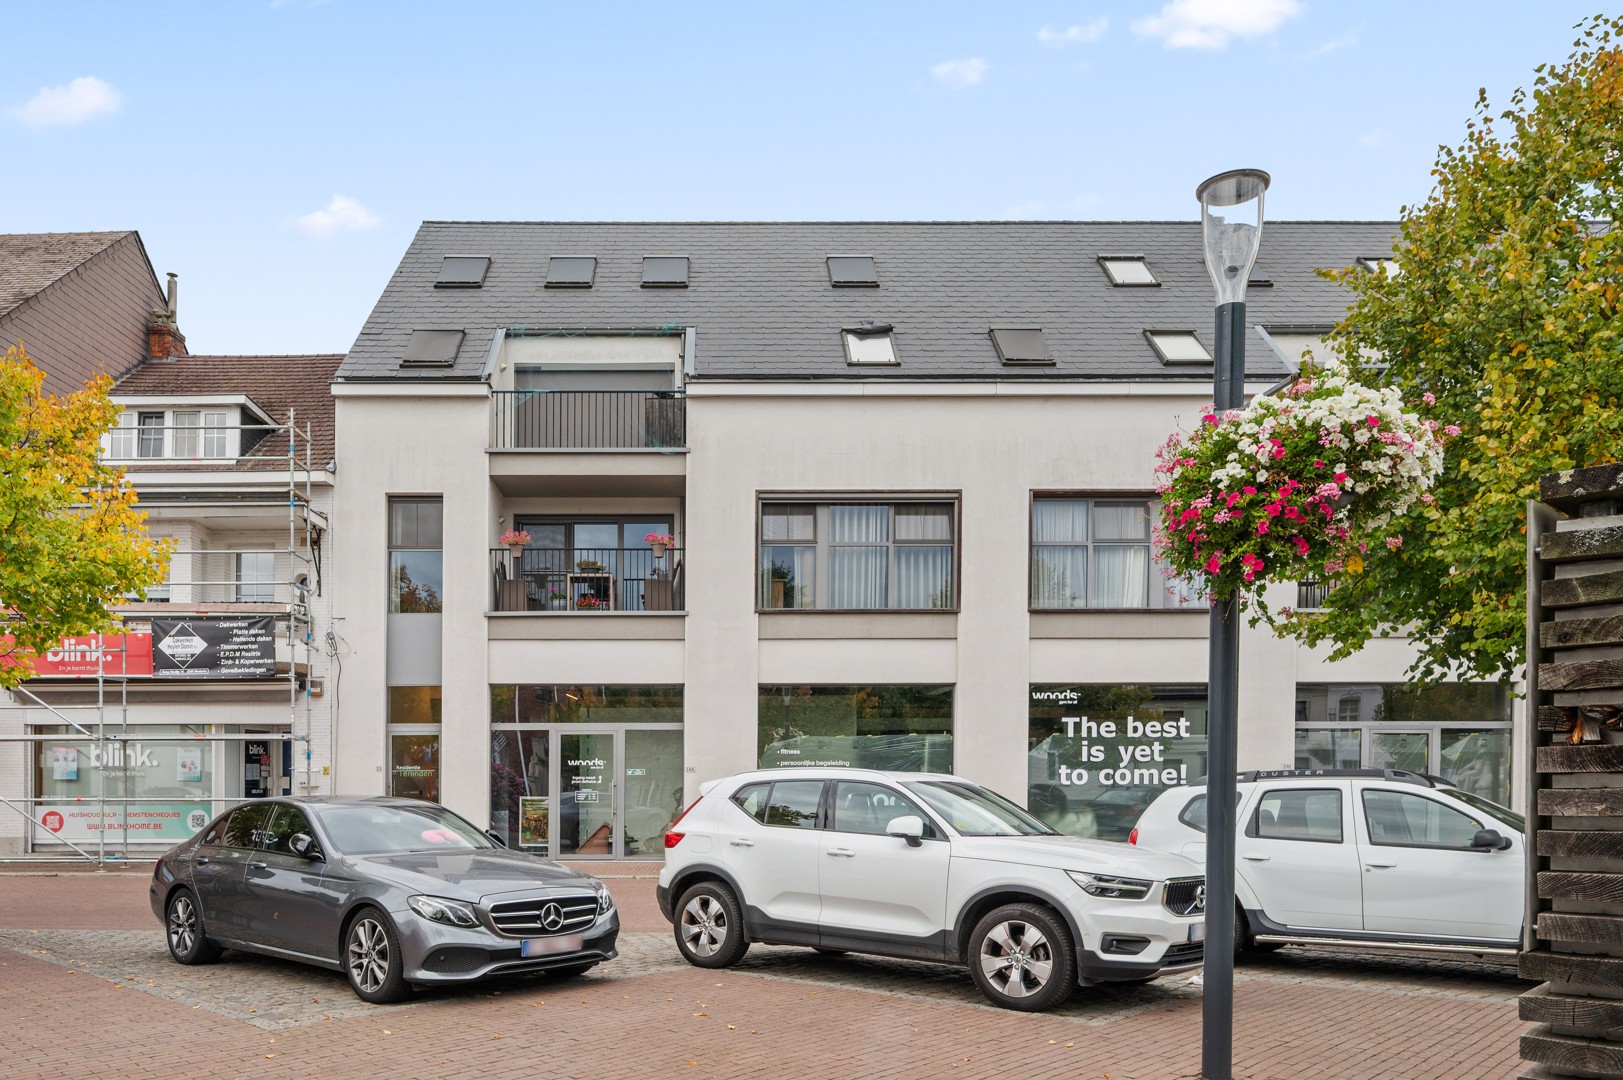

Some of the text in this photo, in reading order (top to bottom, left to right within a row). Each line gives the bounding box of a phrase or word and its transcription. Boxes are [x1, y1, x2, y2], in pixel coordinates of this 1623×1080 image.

[47, 638, 113, 662] blink.
[1062, 716, 1190, 738] The best
[90, 743, 159, 767] blink.
[249, 744, 266, 754] blink.
[1081, 741, 1164, 768] is yet
[1058, 764, 1187, 785] to come!
[124, 811, 181, 819] IENSTENCHEQUES
